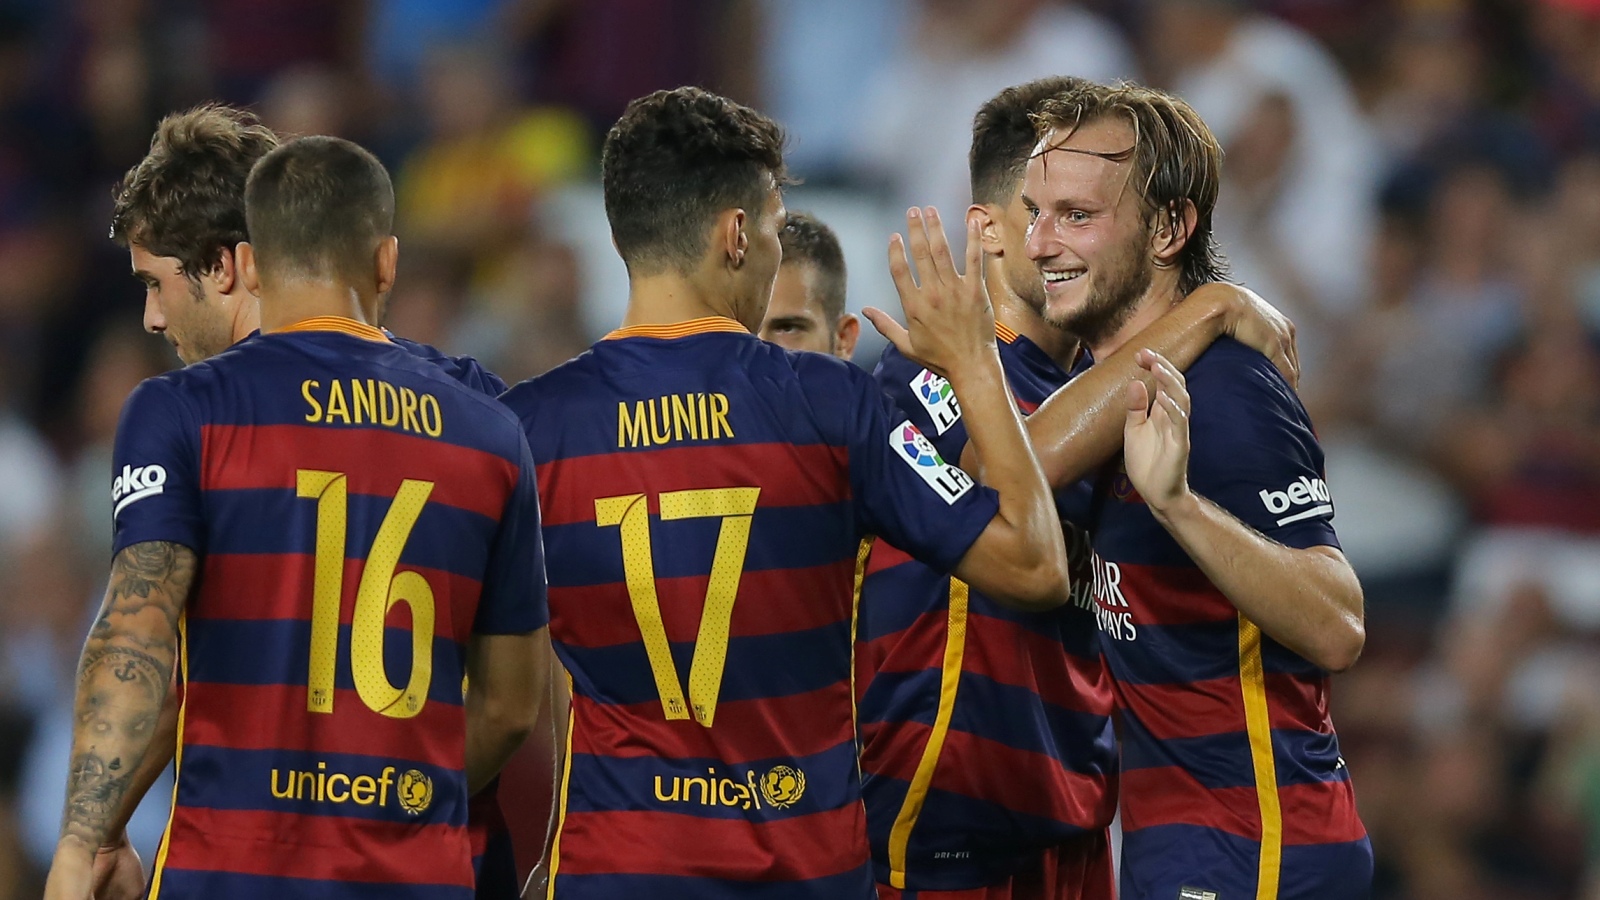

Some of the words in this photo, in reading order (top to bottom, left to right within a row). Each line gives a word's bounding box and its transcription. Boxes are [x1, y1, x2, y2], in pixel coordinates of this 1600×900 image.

[301, 378, 443, 438] SANDRO
[618, 392, 735, 447] MUNIR
[937, 394, 960, 429] LF
[111, 464, 167, 501] eko
[1258, 475, 1331, 514] beko
[296, 469, 435, 719] 16
[594, 486, 761, 728] 17
[271, 761, 396, 807] unicef
[654, 767, 761, 810] unicef
